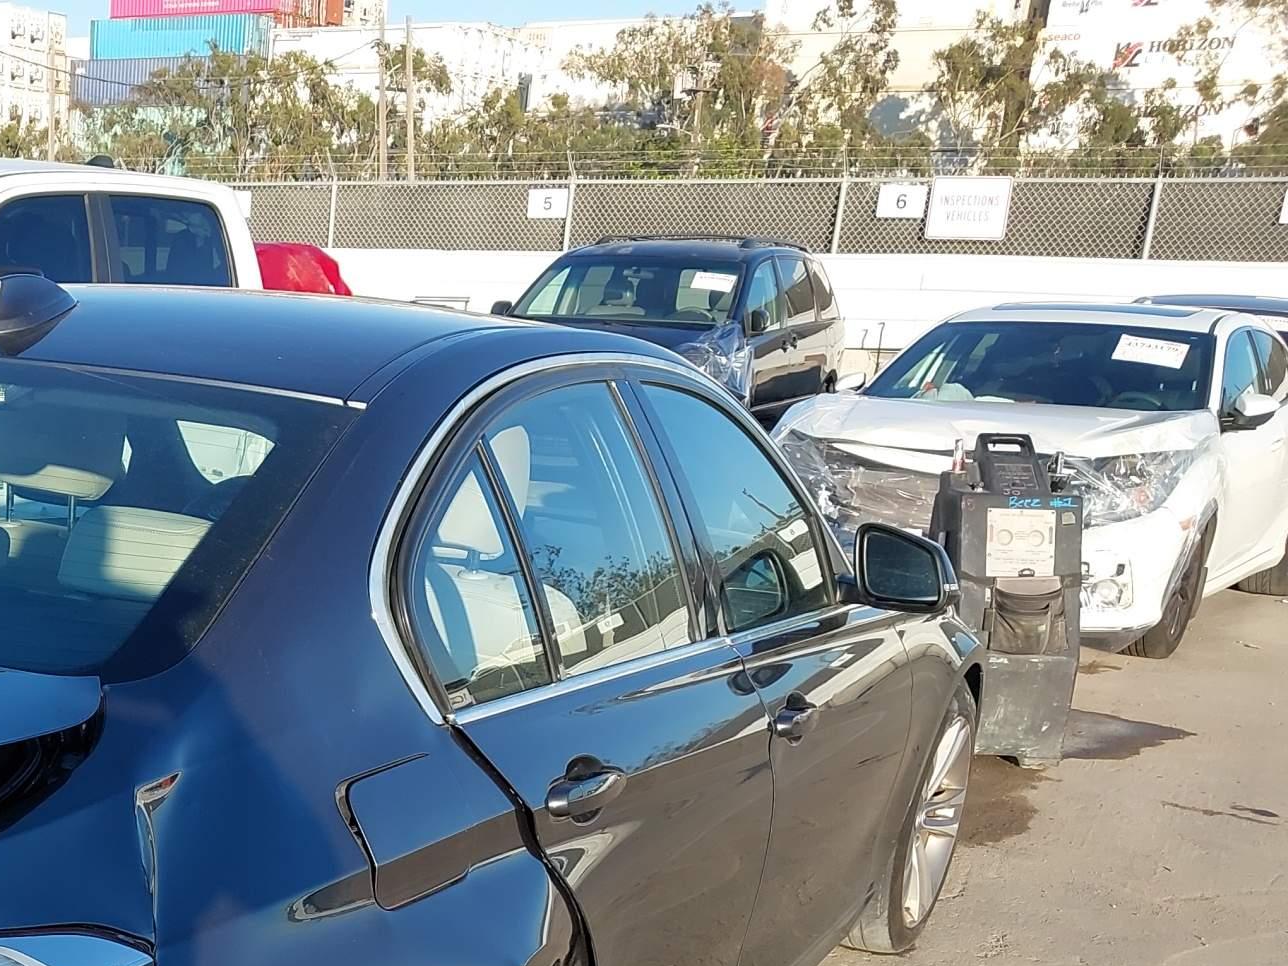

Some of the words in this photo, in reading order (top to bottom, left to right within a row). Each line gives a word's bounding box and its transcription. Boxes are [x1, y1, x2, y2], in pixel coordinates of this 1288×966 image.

[1047, 32, 1081, 41] seaco
[1135, 101, 1225, 119] HIZON
[543, 196, 553, 211] 5
[895, 193, 908, 210] 6
[939, 194, 1001, 207] INSPECTIONS
[945, 210, 990, 223] VEHICLES
